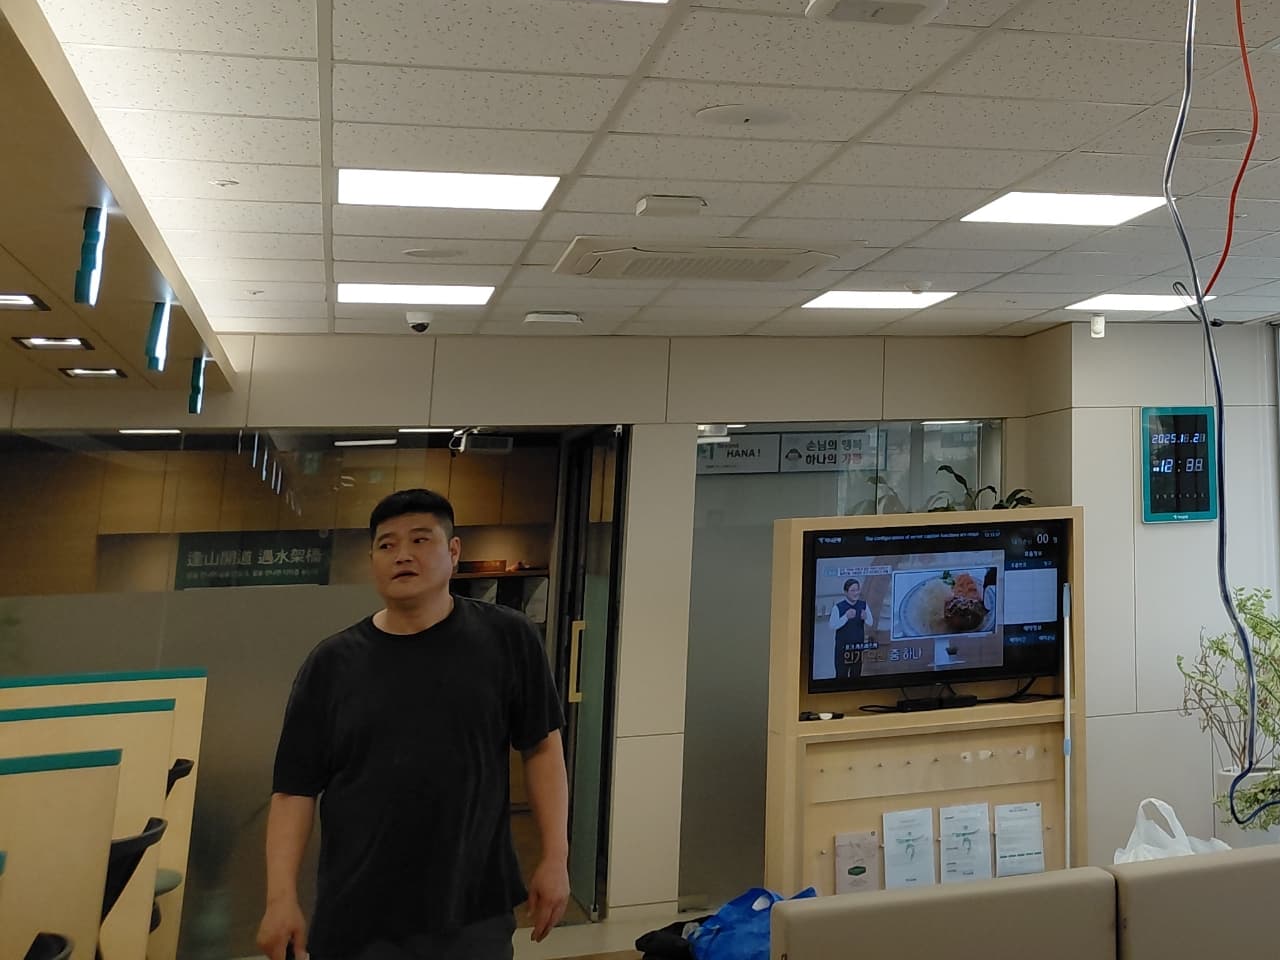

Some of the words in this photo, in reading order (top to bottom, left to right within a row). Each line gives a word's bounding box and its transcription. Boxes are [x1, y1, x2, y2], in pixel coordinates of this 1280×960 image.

[805, 440, 837, 452] 손님의
[805, 453, 837, 465] 하나의
[1036, 533, 1049, 544] 00
